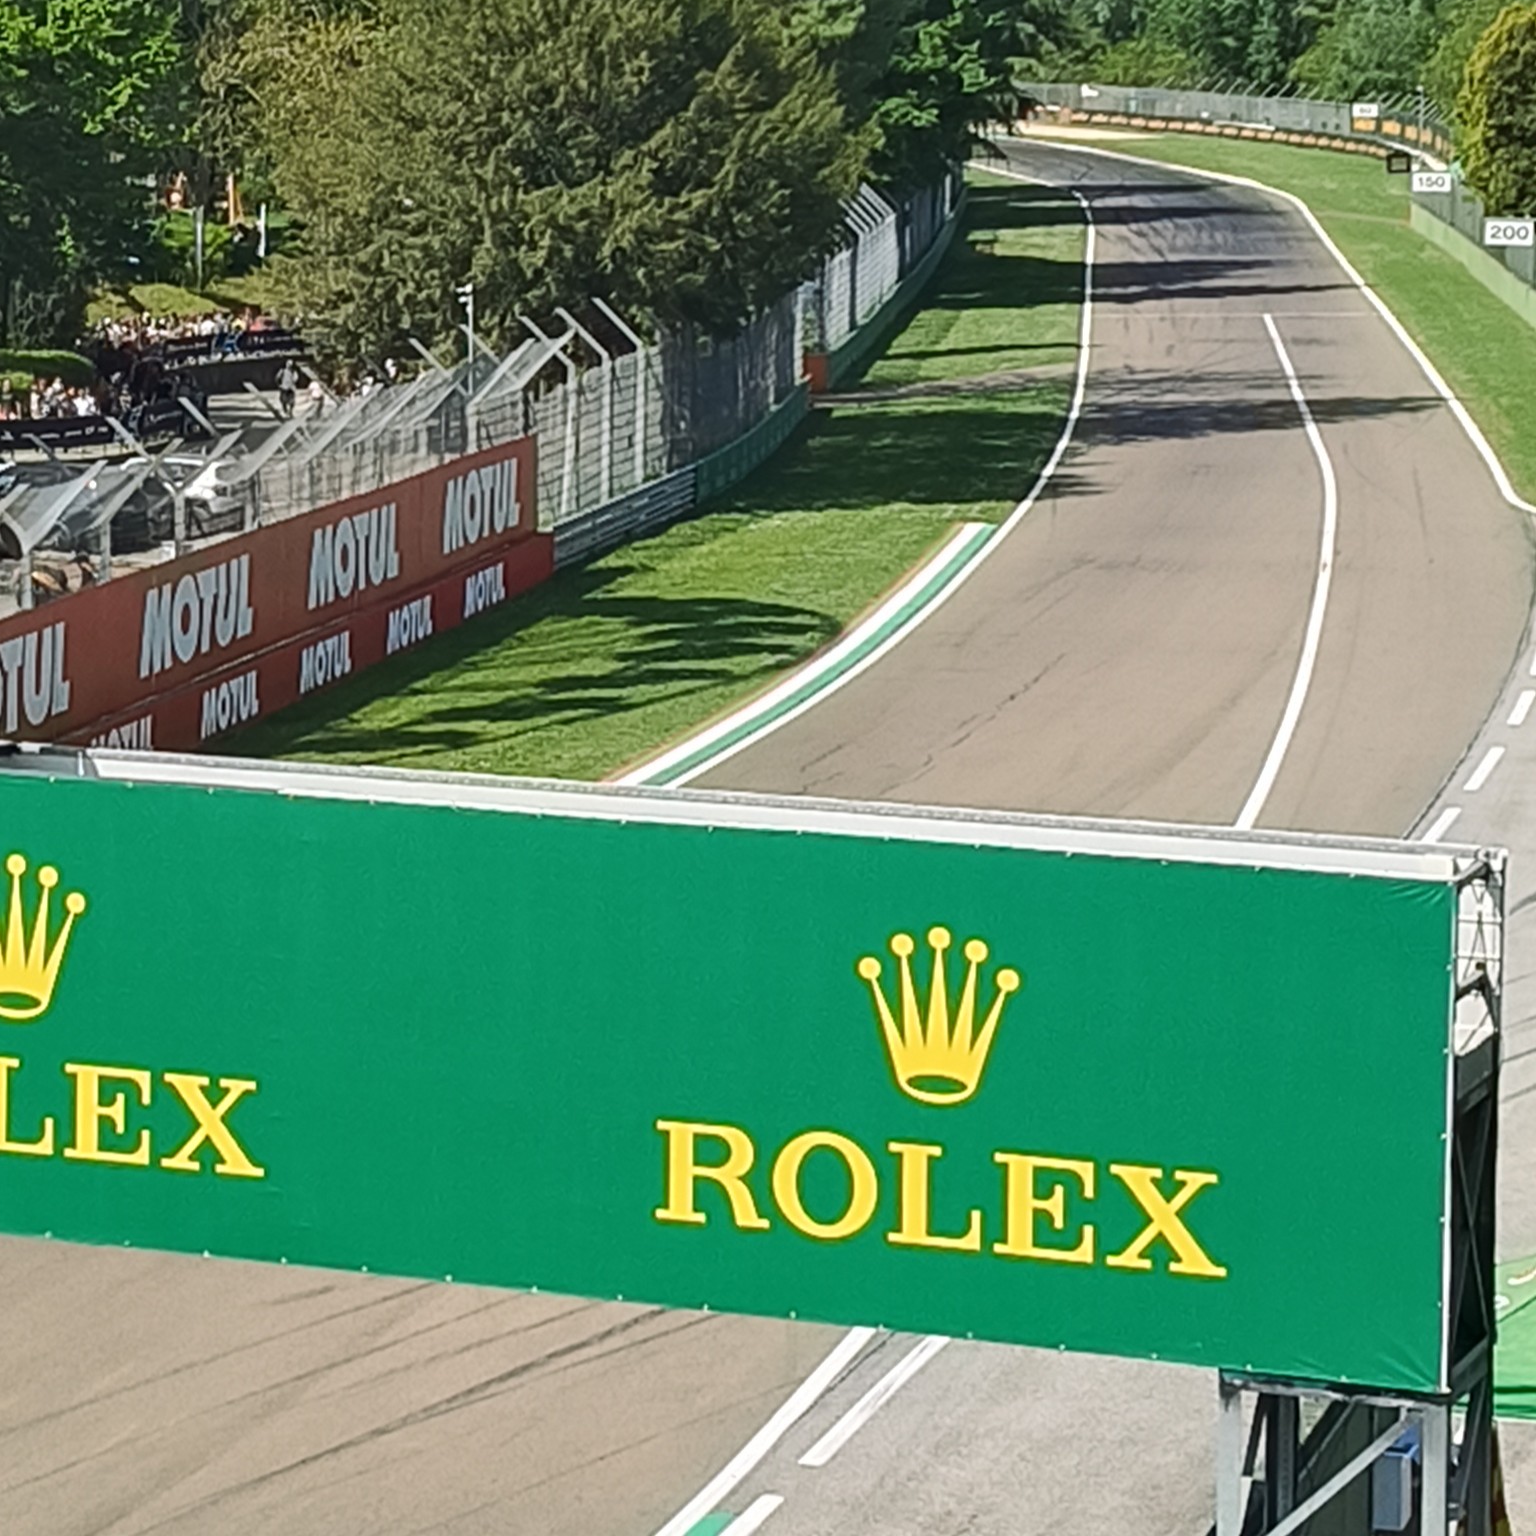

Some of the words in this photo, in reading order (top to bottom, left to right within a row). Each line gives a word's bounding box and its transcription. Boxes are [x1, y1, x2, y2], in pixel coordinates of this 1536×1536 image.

[1418, 175, 1445, 188] 150
[1490, 225, 1529, 240] 200
[443, 457, 520, 555] MOTUL
[307, 503, 399, 611] MOTUL
[464, 562, 506, 619] MOTUL
[139, 553, 254, 680] MOTUL
[386, 594, 433, 655] MOTUL
[299, 630, 351, 694] MOTUL
[200, 669, 259, 740] MOTUL
[653, 1119, 1227, 1280] ROLEX
